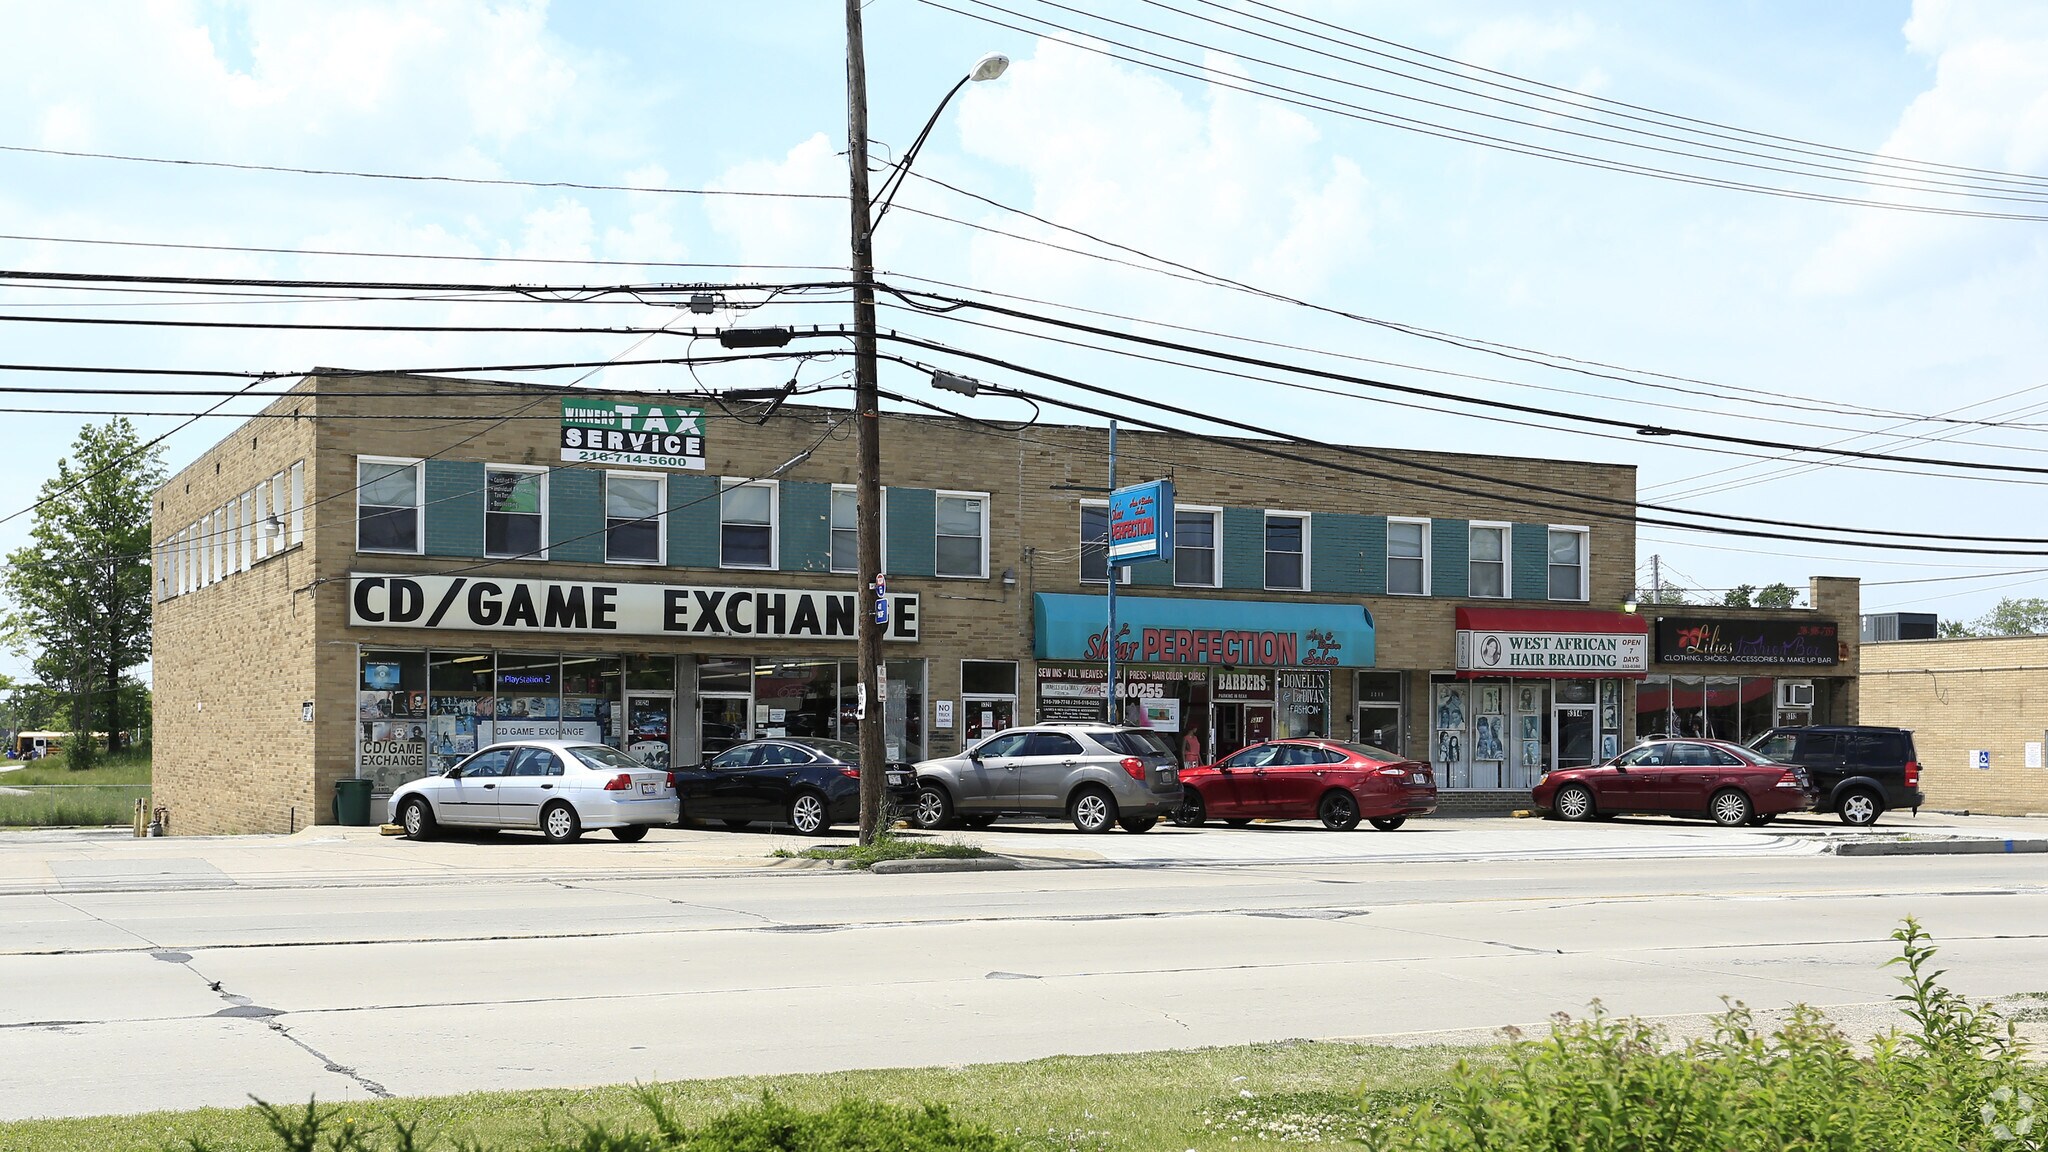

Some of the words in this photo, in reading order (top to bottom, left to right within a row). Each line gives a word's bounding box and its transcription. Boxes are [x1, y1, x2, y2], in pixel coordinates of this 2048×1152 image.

[564, 407, 615, 426] WINNERS
[615, 405, 701, 435] TAX
[565, 428, 701, 456] SERVICE
[579, 451, 687, 467] 216-714-5600
[1112, 517, 1154, 541] PERFECTION
[353, 578, 618, 630] CD/GAME
[663, 589, 917, 638] EXCHANE
[1083, 624, 1139, 660] Shar
[1142, 628, 1297, 666] PERFECTION
[1509, 637, 1551, 650] WEST
[1555, 637, 1617, 651] AFRICAN
[1686, 624, 1733, 655] Lilies
[1302, 649, 1339, 666] Salon
[1510, 654, 1545, 666] HAIR
[1549, 655, 1617, 667] BRAIDING
[1731, 655, 1778, 663] ACCESSORIES
[504, 675, 544, 685] PlayStation
[544, 674, 551, 684] 2
[1038, 667, 1051, 678] SEW
[1052, 668, 1062, 678] INS
[1067, 669, 1078, 678] ALL
[1080, 669, 1103, 679] WEAVES
[1129, 670, 1147, 680] PRESS
[1151, 671, 1165, 680] HAIR
[1166, 672, 1183, 681] COLOR
[1188, 672, 1206, 681] CURLS
[1283, 673, 1325, 688] DONELL'S
[938, 704, 950, 712] NO
[496, 727, 508, 736] CD
[510, 727, 534, 736] GAME
[538, 727, 584, 736] EXCHANGE
[363, 741, 423, 755] CD/GAME
[361, 755, 424, 766] EXCHANGE
